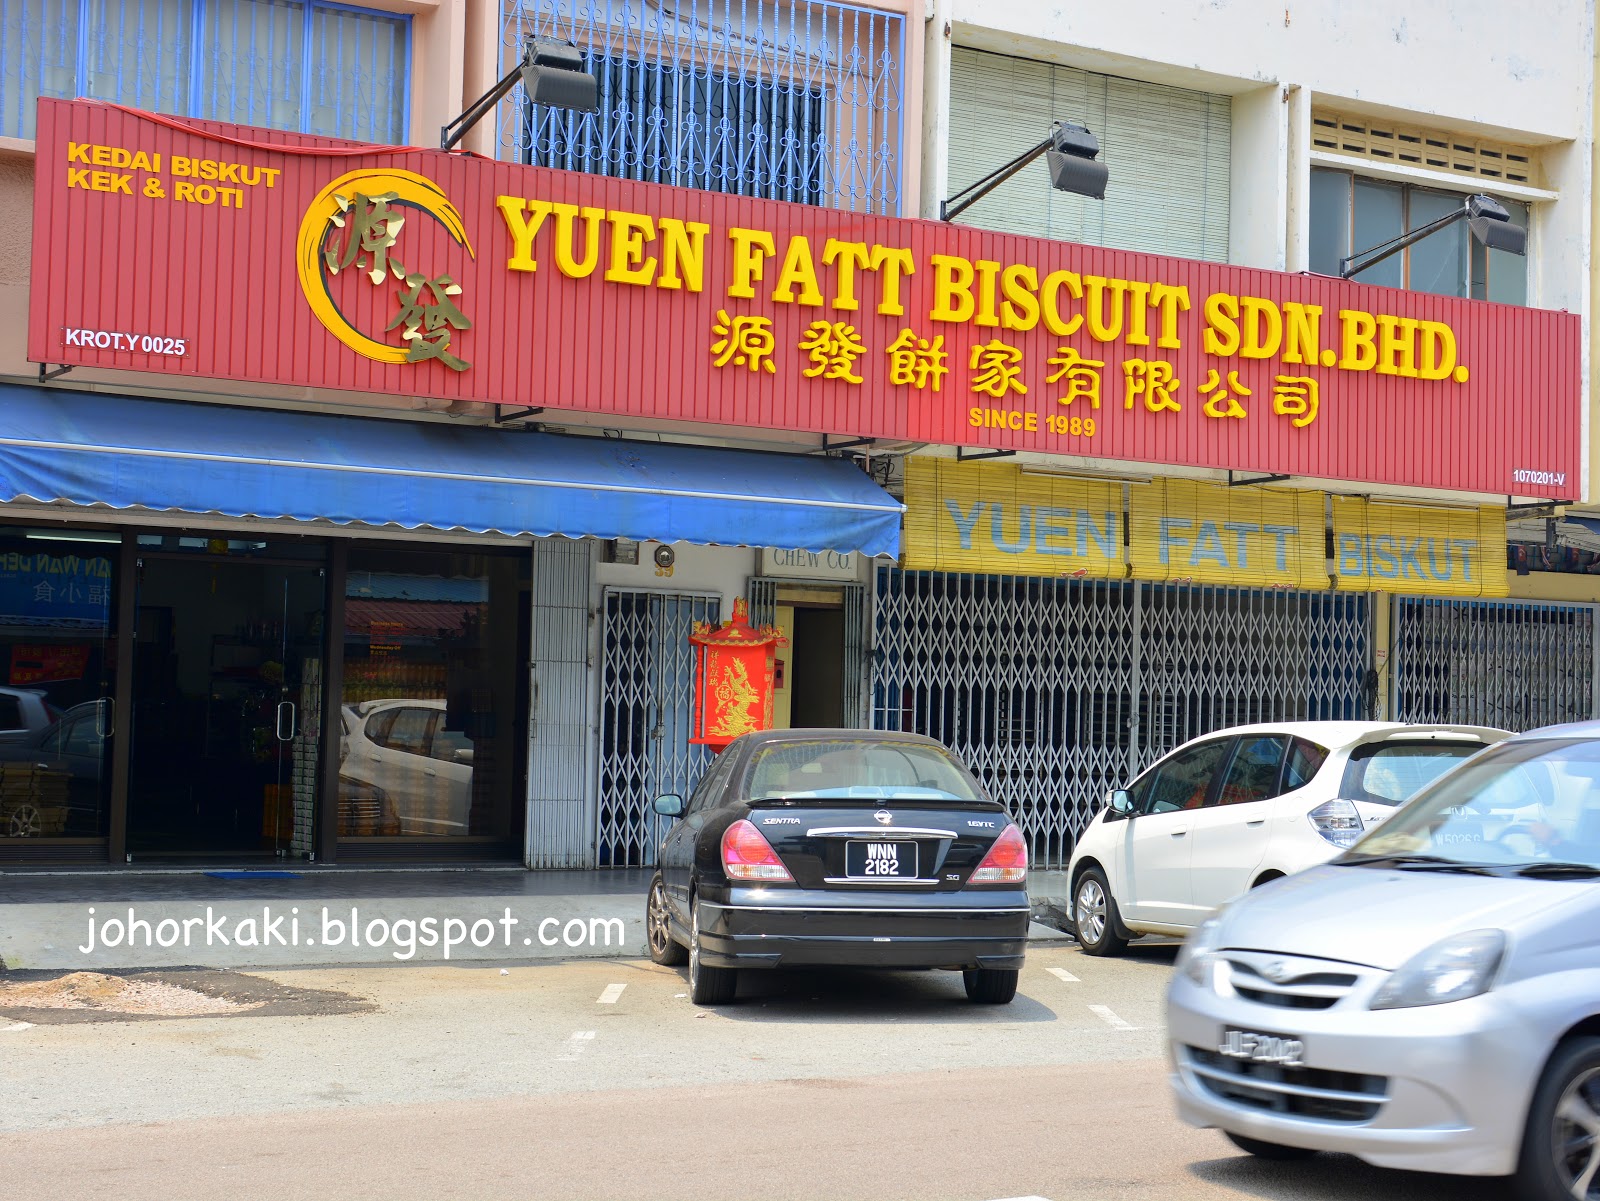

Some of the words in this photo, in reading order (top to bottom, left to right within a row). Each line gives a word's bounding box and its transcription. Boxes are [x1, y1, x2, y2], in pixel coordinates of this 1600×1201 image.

[67, 141, 161, 173] KEDAI
[171, 156, 281, 189] BISKUT
[67, 166, 134, 195] KEK
[142, 177, 166, 199] &
[174, 182, 244, 209] ROTI
[497, 195, 710, 293] YUEN
[728, 227, 916, 317] FATT
[928, 253, 1191, 349] BISCUIT
[141, 335, 186, 356] 0025
[710, 309, 1321, 428] 源發餅家有限公司
[969, 407, 1038, 432] SINCE
[1045, 414, 1097, 438] 1989
[1513, 469, 1565, 486] 1070201-V
[945, 498, 1117, 559] YUEN
[1158, 517, 1297, 571] FATT
[1338, 533, 1478, 582] BISKUT
[865, 859, 899, 875] 2182
[867, 843, 897, 859] WNN
